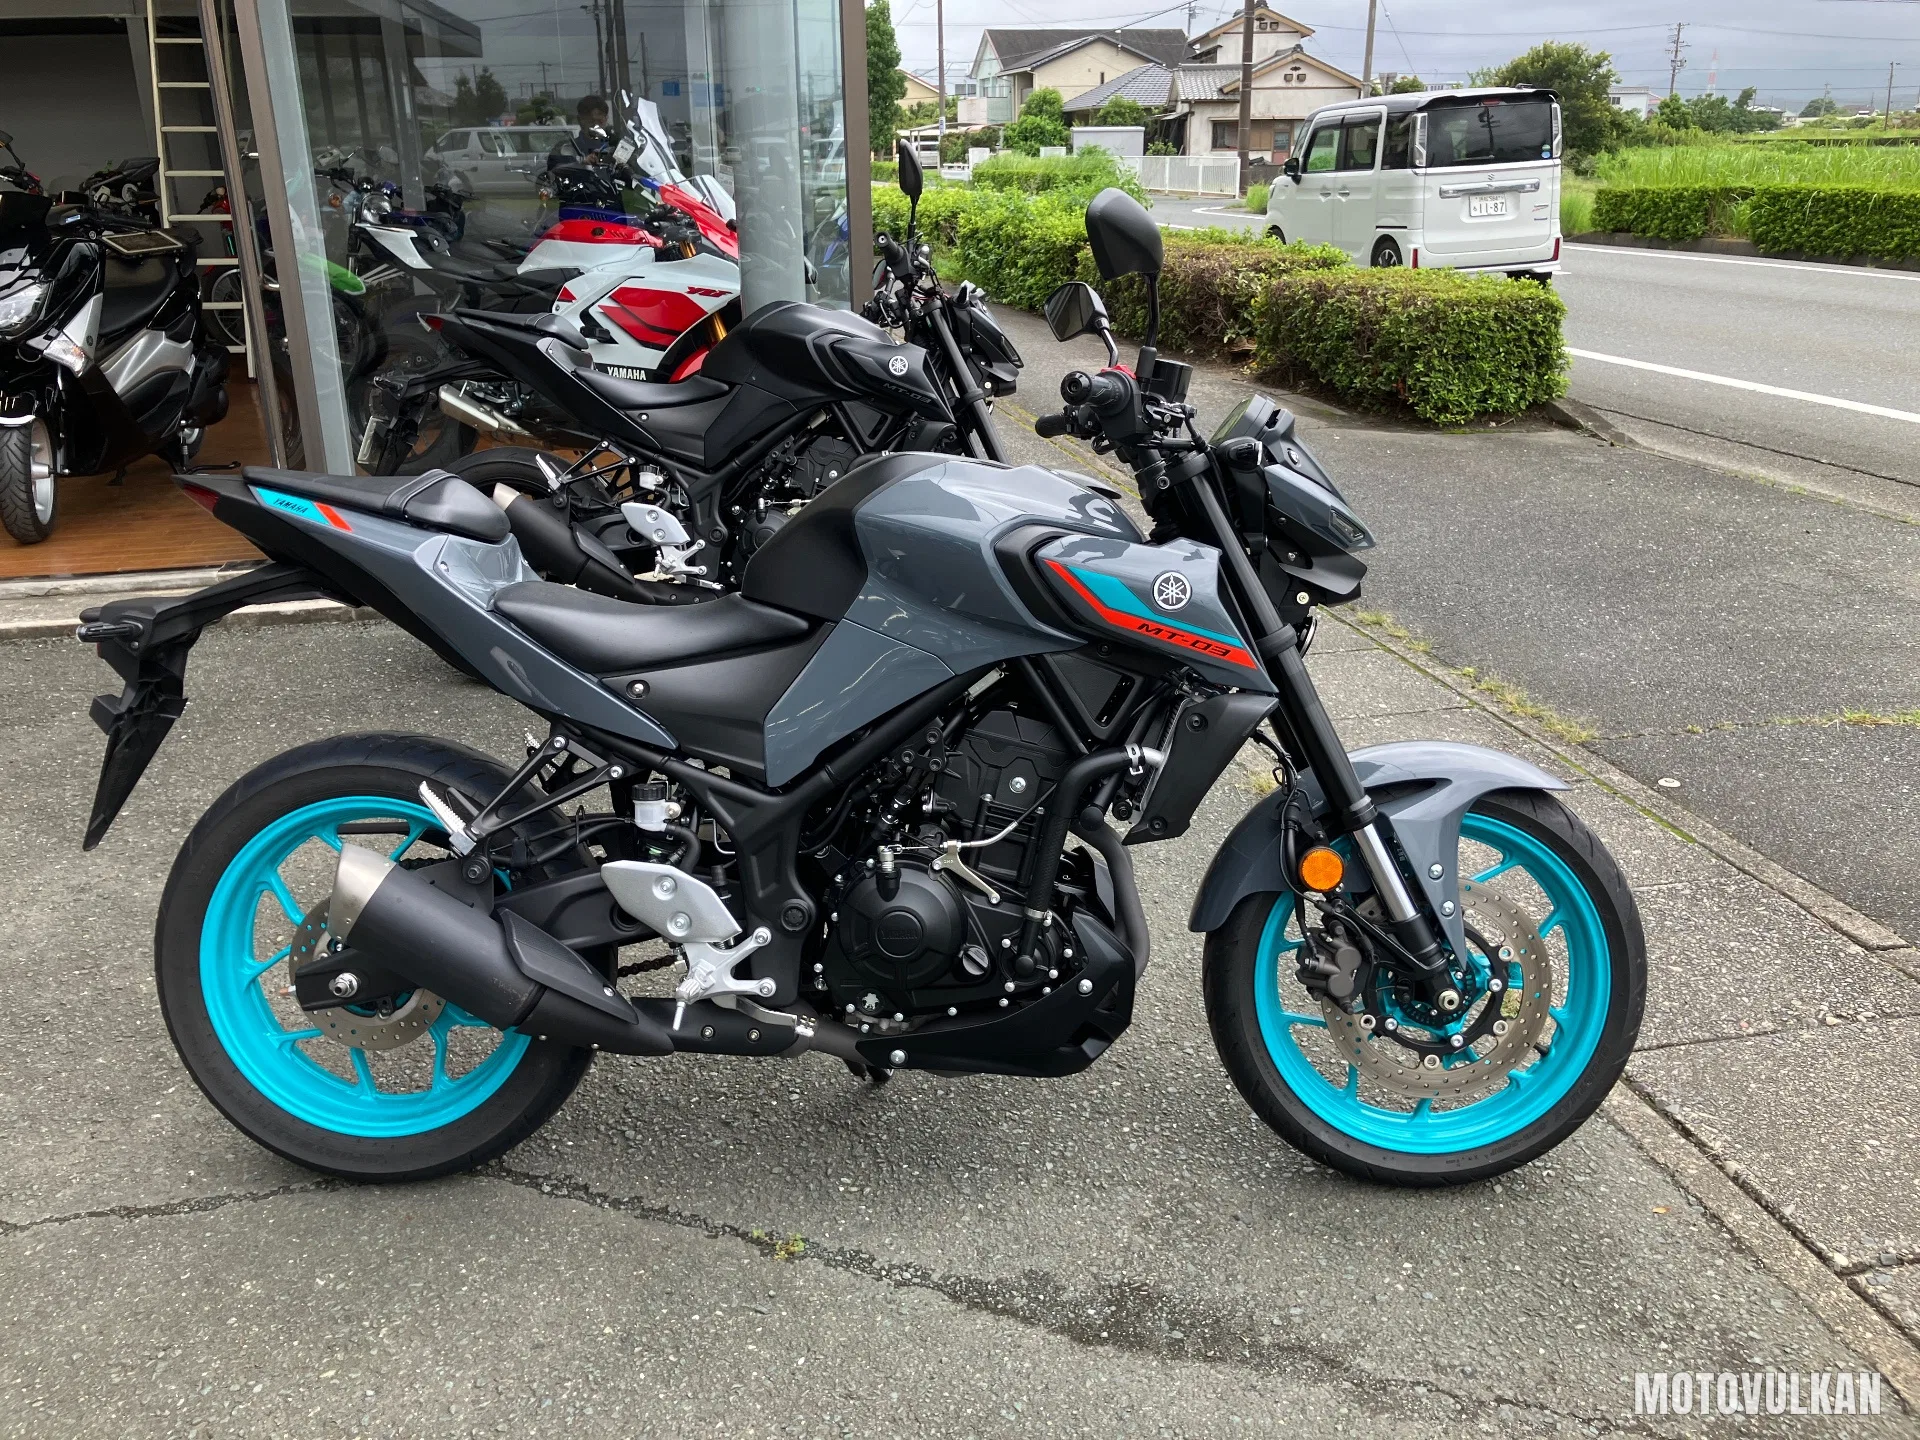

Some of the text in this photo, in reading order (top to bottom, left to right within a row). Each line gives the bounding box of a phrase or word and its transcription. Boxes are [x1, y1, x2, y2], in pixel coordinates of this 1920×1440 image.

[607, 366, 647, 381] YAMAHA
[273, 498, 309, 514] YAMAHA
[1137, 623, 1232, 657] MT-03
